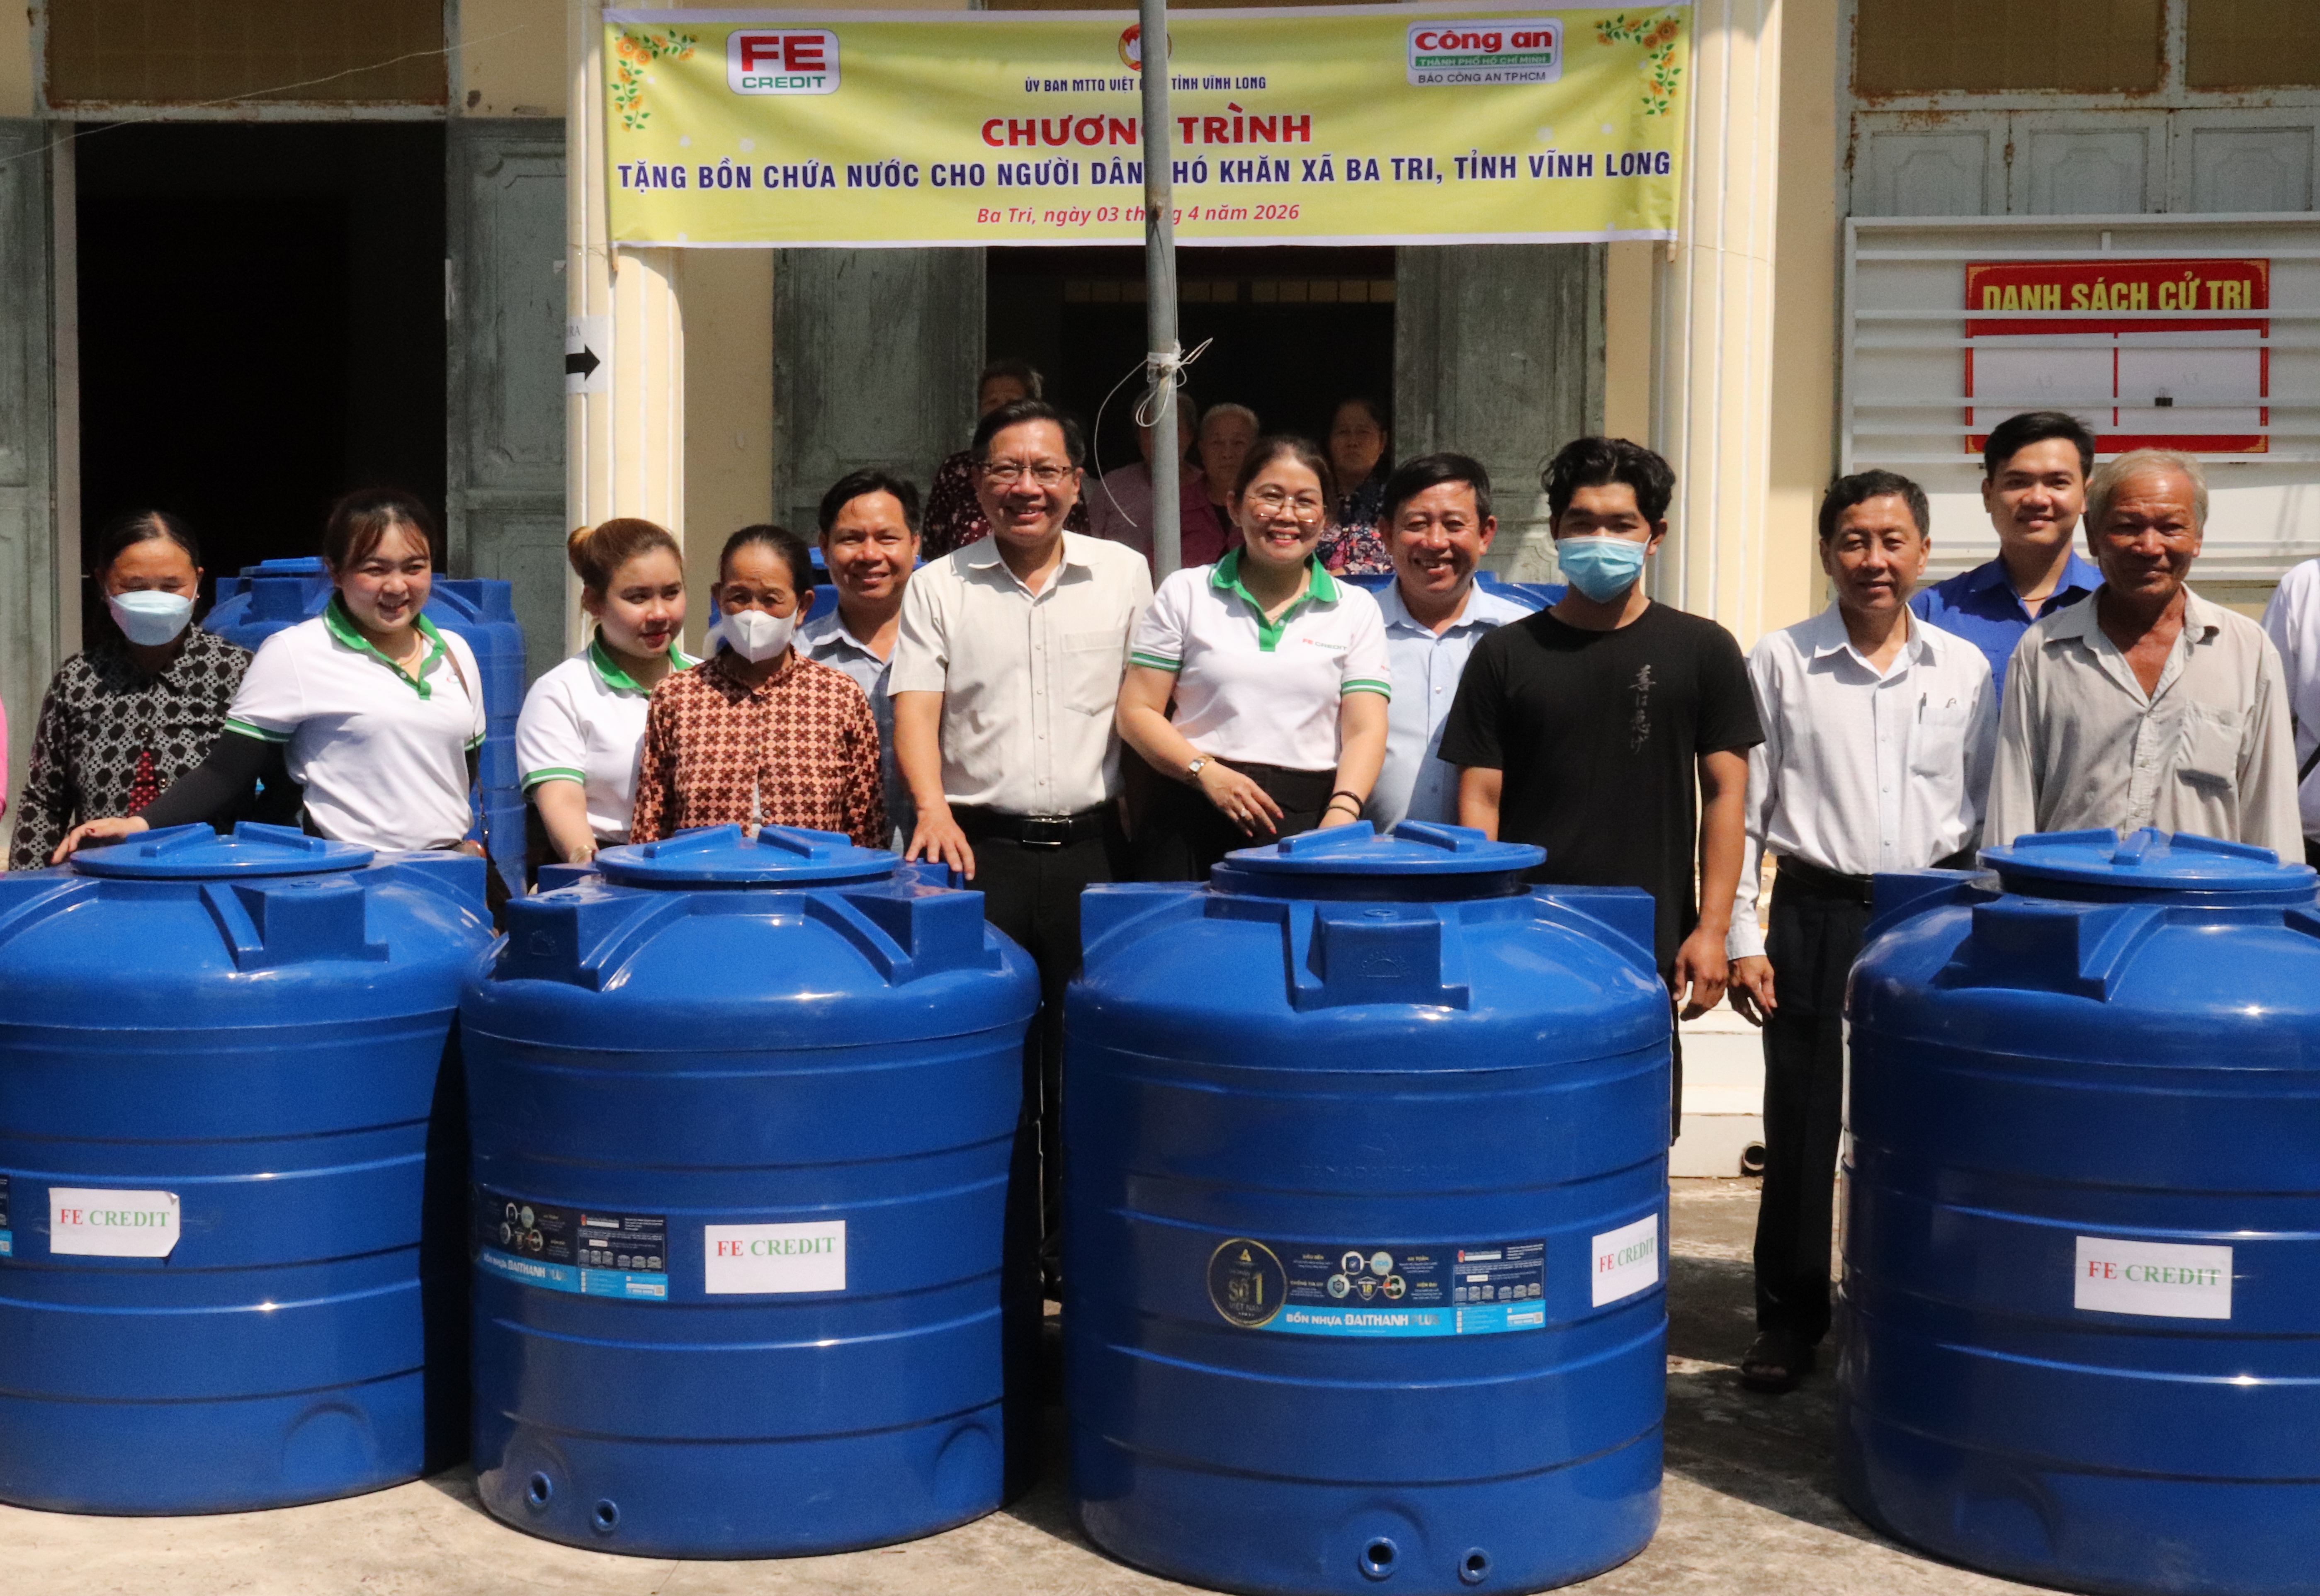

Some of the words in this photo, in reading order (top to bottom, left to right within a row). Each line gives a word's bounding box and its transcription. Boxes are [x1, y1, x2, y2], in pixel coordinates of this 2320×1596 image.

[1415, 30, 1502, 53] Công
[1511, 32, 1552, 48] an
[740, 36, 826, 71] FE
[741, 75, 826, 89] CREDIT
[1025, 77, 1040, 92] ỦY
[1045, 80, 1067, 92] BAN
[1073, 79, 1105, 92] MTTQ
[1110, 77, 1134, 94] VIỆT
[1171, 75, 1198, 90] TỈNH
[1203, 76, 1231, 90] VĨNH
[1236, 77, 1266, 89] LONG
[1447, 71, 1481, 82] CÔNG
[1485, 73, 1501, 82] AN
[1504, 72, 1546, 81] TPHCM
[981, 114, 1143, 146] CHƯƠN
[1177, 102, 1311, 144] TRÌNH
[618, 160, 686, 193] TẶNG
[699, 158, 751, 189] BỒN
[764, 160, 836, 188] CHỨA
[847, 158, 919, 187] NƯỚC
[931, 163, 985, 187] CHO
[998, 157, 1079, 186] NGƯỜI
[1092, 157, 1143, 184] DÂN
[1173, 155, 1207, 184] HÓ
[1220, 155, 1290, 183] KHĂN
[1302, 153, 1334, 182] XÃ
[1346, 159, 1380, 182] BA
[1391, 158, 1442, 184] TRI,
[1454, 150, 1516, 179] TỈNH
[1528, 148, 1593, 178] VĨNH
[1606, 152, 1670, 177] LONG
[977, 208, 1001, 223] Ba
[1008, 207, 1036, 225] Tri,
[1044, 206, 1091, 226] ngày
[1097, 207, 1119, 221] 03
[1125, 205, 1182, 226] thg
[1188, 206, 1199, 221] 4
[1205, 204, 1247, 220] năm
[1254, 204, 1300, 219] 2026
[1982, 284, 2061, 310] DANH
[2071, 277, 2148, 310] SÁCH
[2159, 271, 2201, 310] CỬ
[2207, 279, 2252, 310] TRI
[1315, 641, 1348, 651] CREDIT
[61, 1209, 83, 1225] FE
[89, 1210, 170, 1227] CREDIT
[717, 1241, 743, 1256] FE
[751, 1237, 836, 1256] CREDIT
[1599, 1254, 1615, 1273] FE
[1617, 1236, 1654, 1267] CREDIT
[2089, 1261, 2117, 1279] FE
[2125, 1264, 2221, 1286] CREDIT
